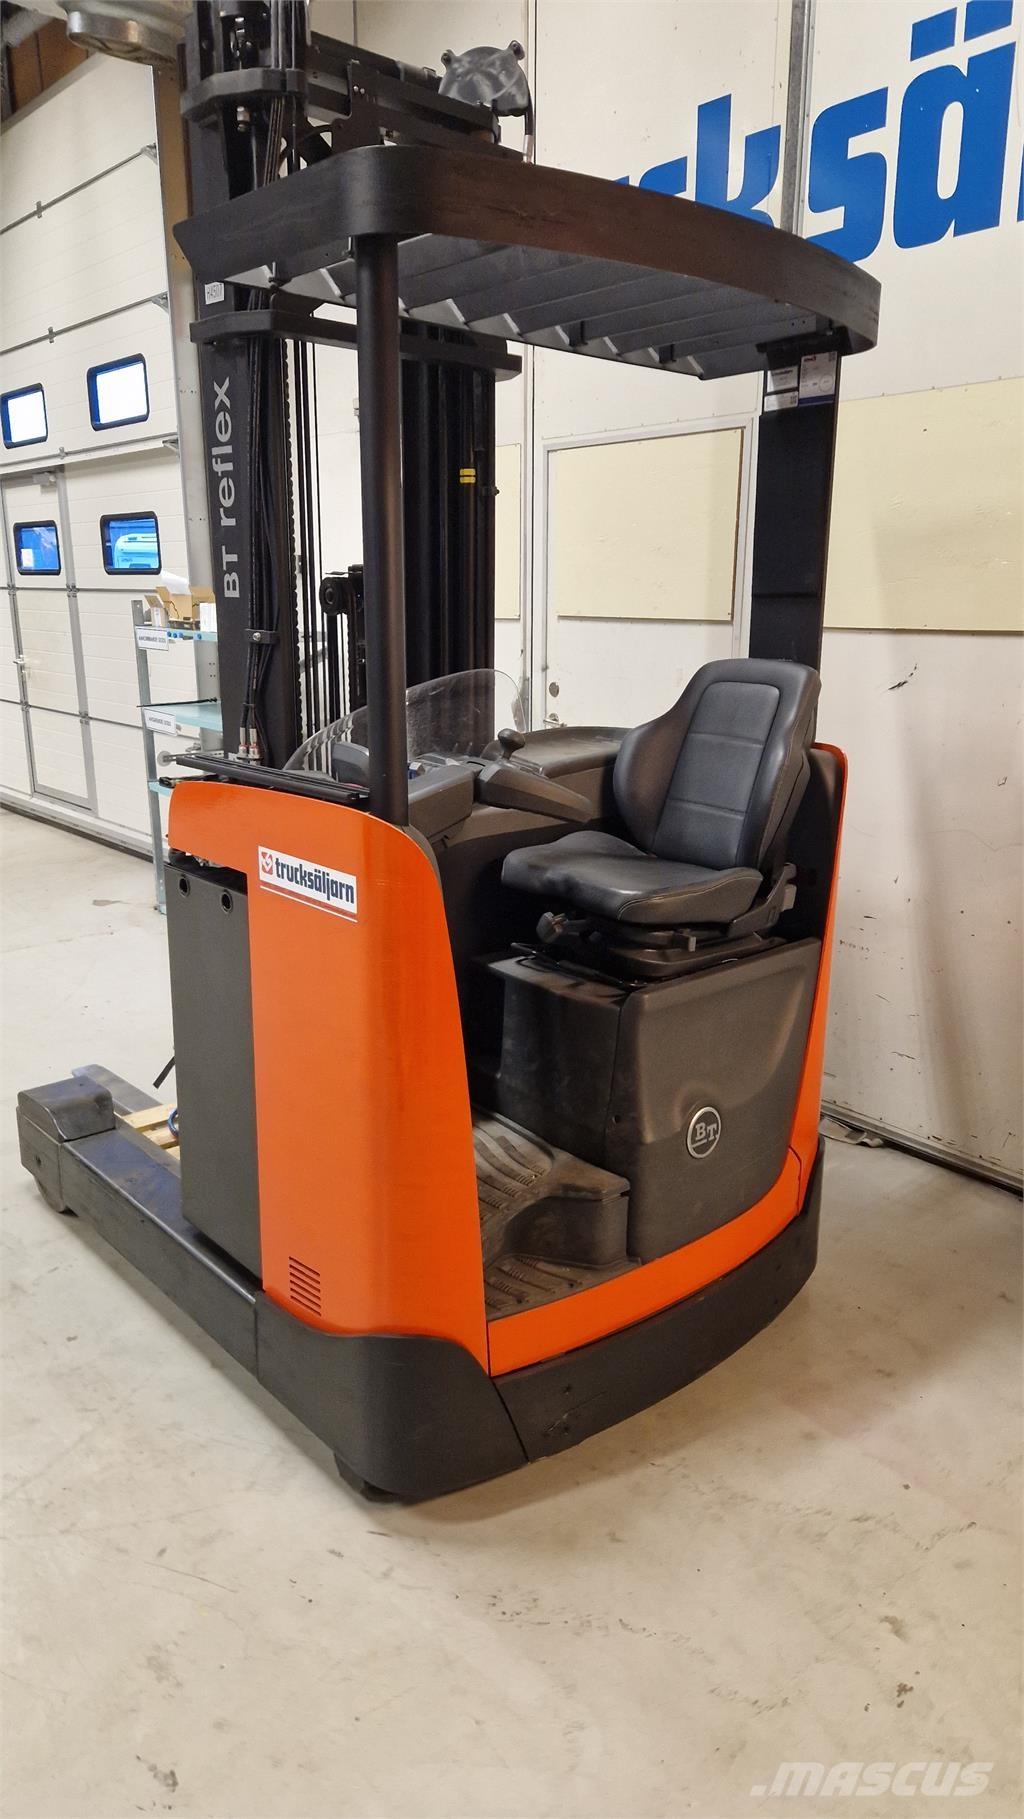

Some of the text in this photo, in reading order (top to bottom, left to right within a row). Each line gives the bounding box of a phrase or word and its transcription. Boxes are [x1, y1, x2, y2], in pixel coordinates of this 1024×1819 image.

[211, 377, 240, 598] BT reflex
[274, 857, 355, 904] trucksäljarn
[695, 1121, 718, 1141] BT
